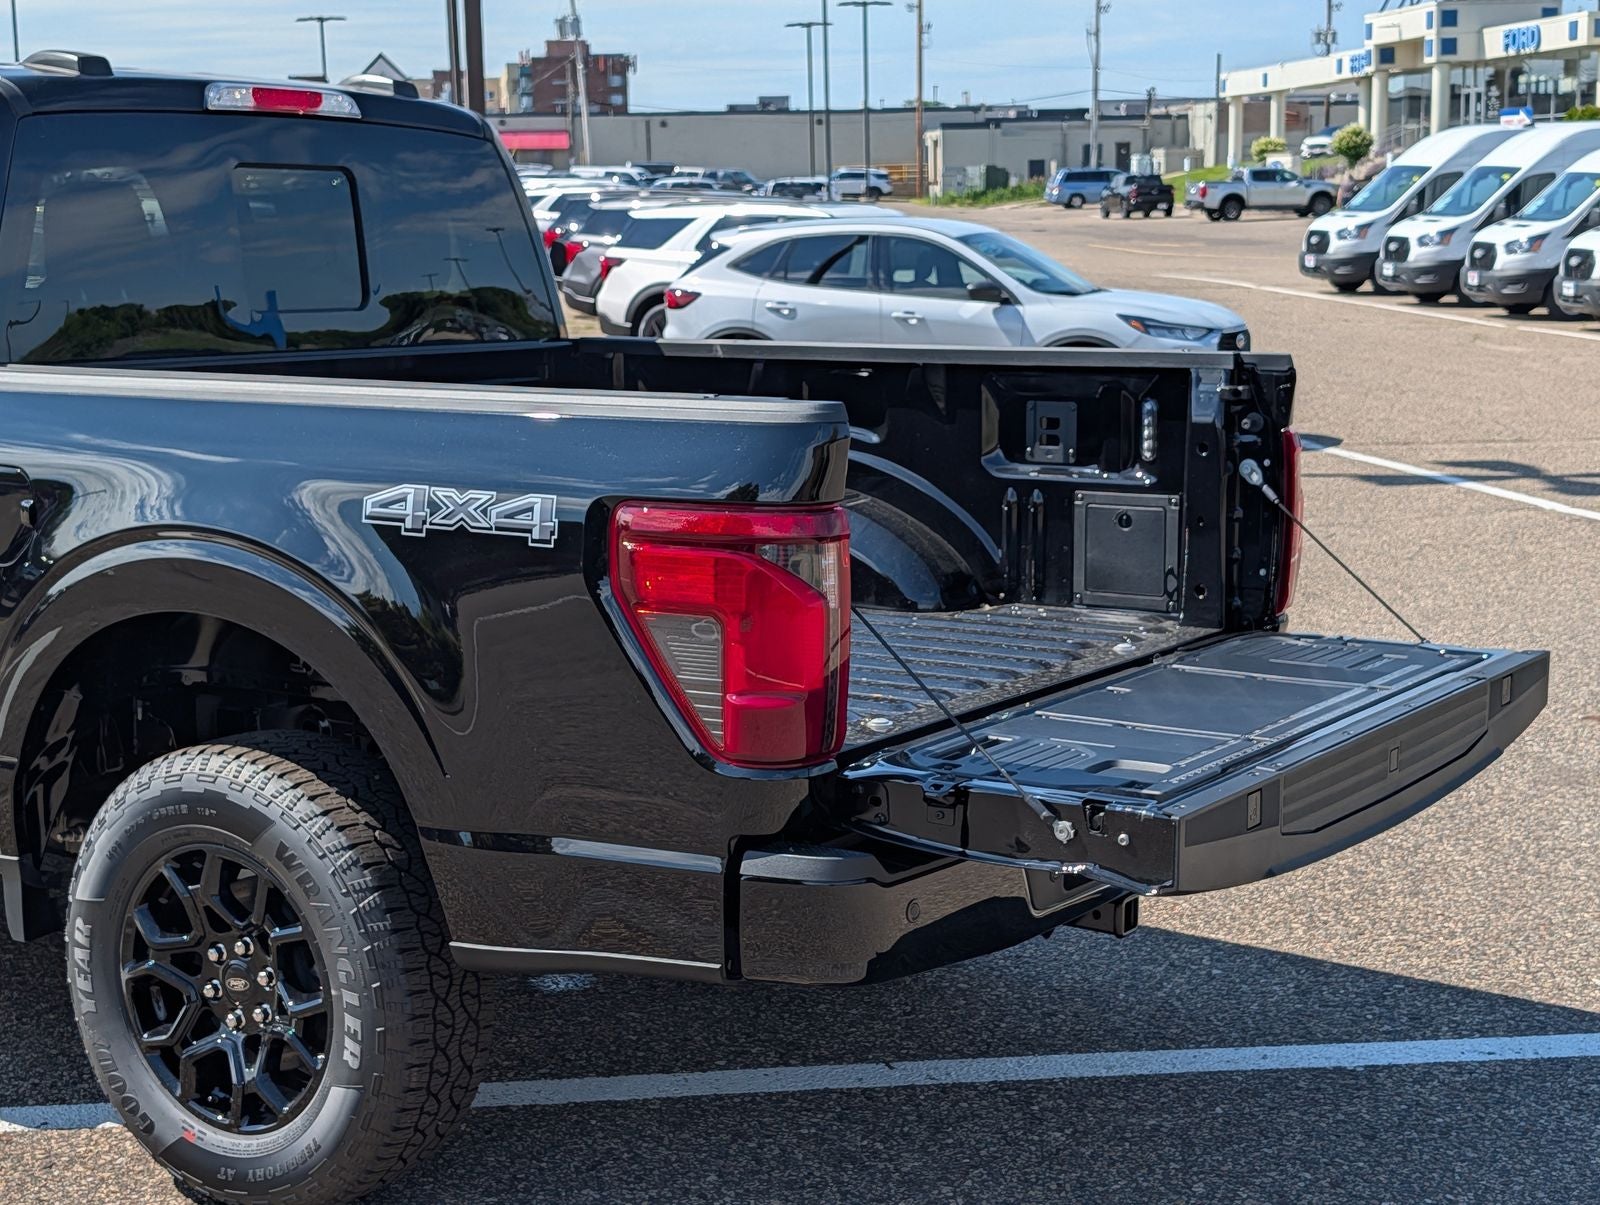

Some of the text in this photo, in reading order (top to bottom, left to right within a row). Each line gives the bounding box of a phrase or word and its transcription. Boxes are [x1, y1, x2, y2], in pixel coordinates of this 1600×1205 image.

[1503, 25, 1541, 53] FORD
[275, 840, 362, 1069] WRANGLER
[217, 1137, 322, 1182] TERRITORY AT
